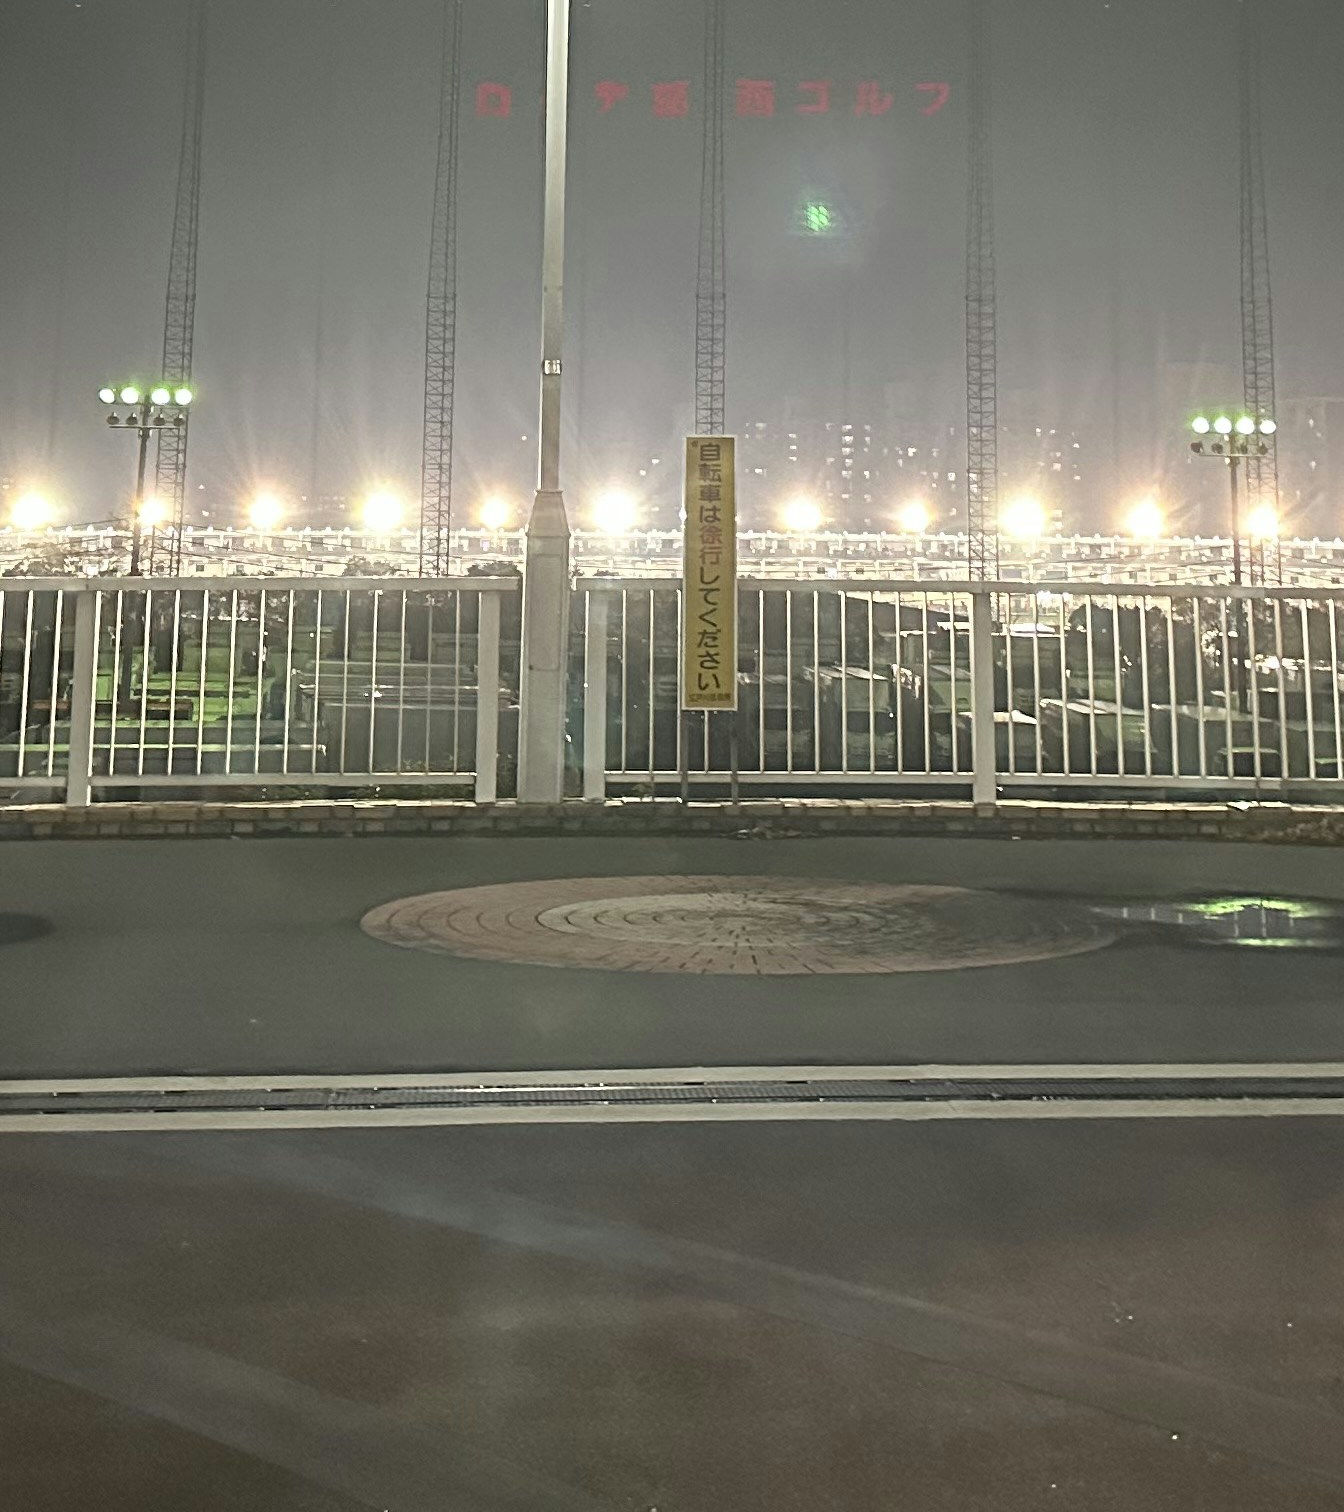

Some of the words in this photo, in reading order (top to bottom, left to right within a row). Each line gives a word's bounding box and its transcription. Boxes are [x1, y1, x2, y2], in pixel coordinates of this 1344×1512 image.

[697, 442, 722, 691] 自転車は徐行してください
